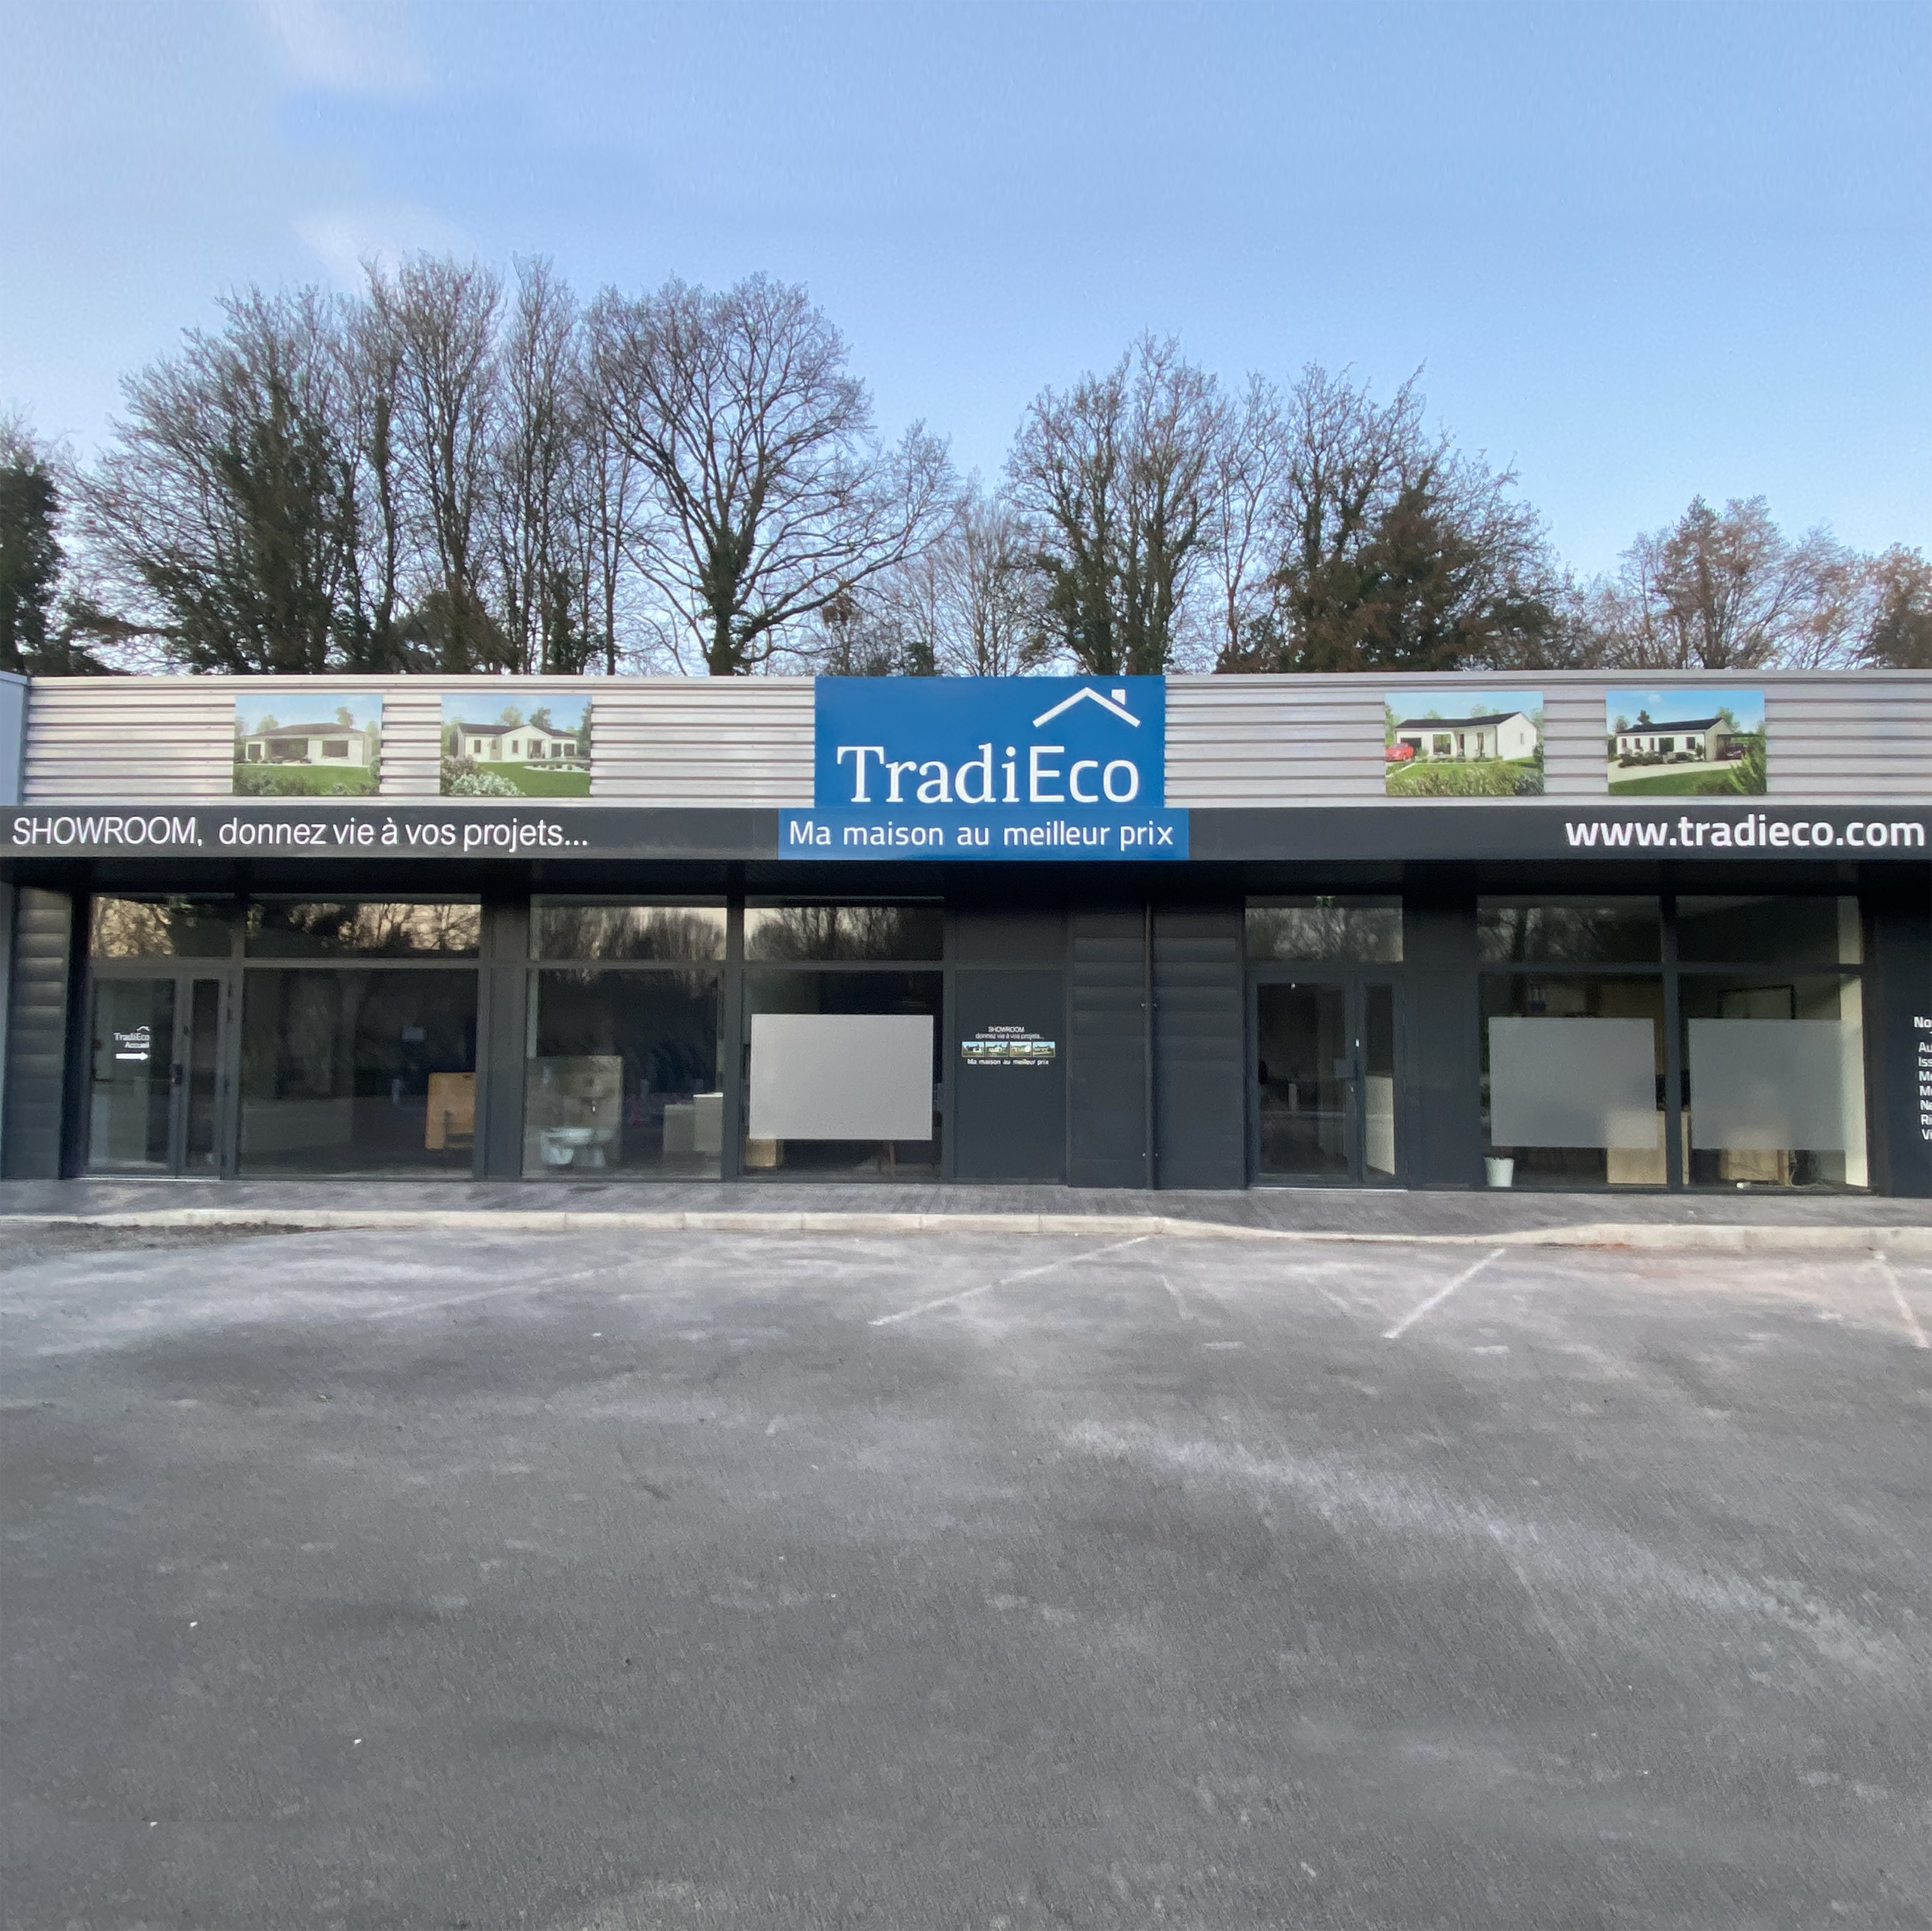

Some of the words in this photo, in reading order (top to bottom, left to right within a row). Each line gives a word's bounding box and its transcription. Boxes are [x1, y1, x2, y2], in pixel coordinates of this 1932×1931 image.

[837, 743, 1139, 804] TradiEco
[12, 816, 203, 847] SHOWROOM,
[218, 817, 327, 845] donnez
[333, 817, 375, 846] vie
[381, 817, 398, 846] à
[405, 824, 456, 846] vos
[463, 817, 588, 853] projets...
[790, 820, 832, 846] Ma
[843, 821, 944, 846] maison
[957, 827, 990, 846] au
[1004, 820, 1111, 846] meilleur
[1120, 820, 1173, 852] prix
[1565, 813, 1925, 847] www.tradieco.com
[1914, 1016, 1932, 1028] No
